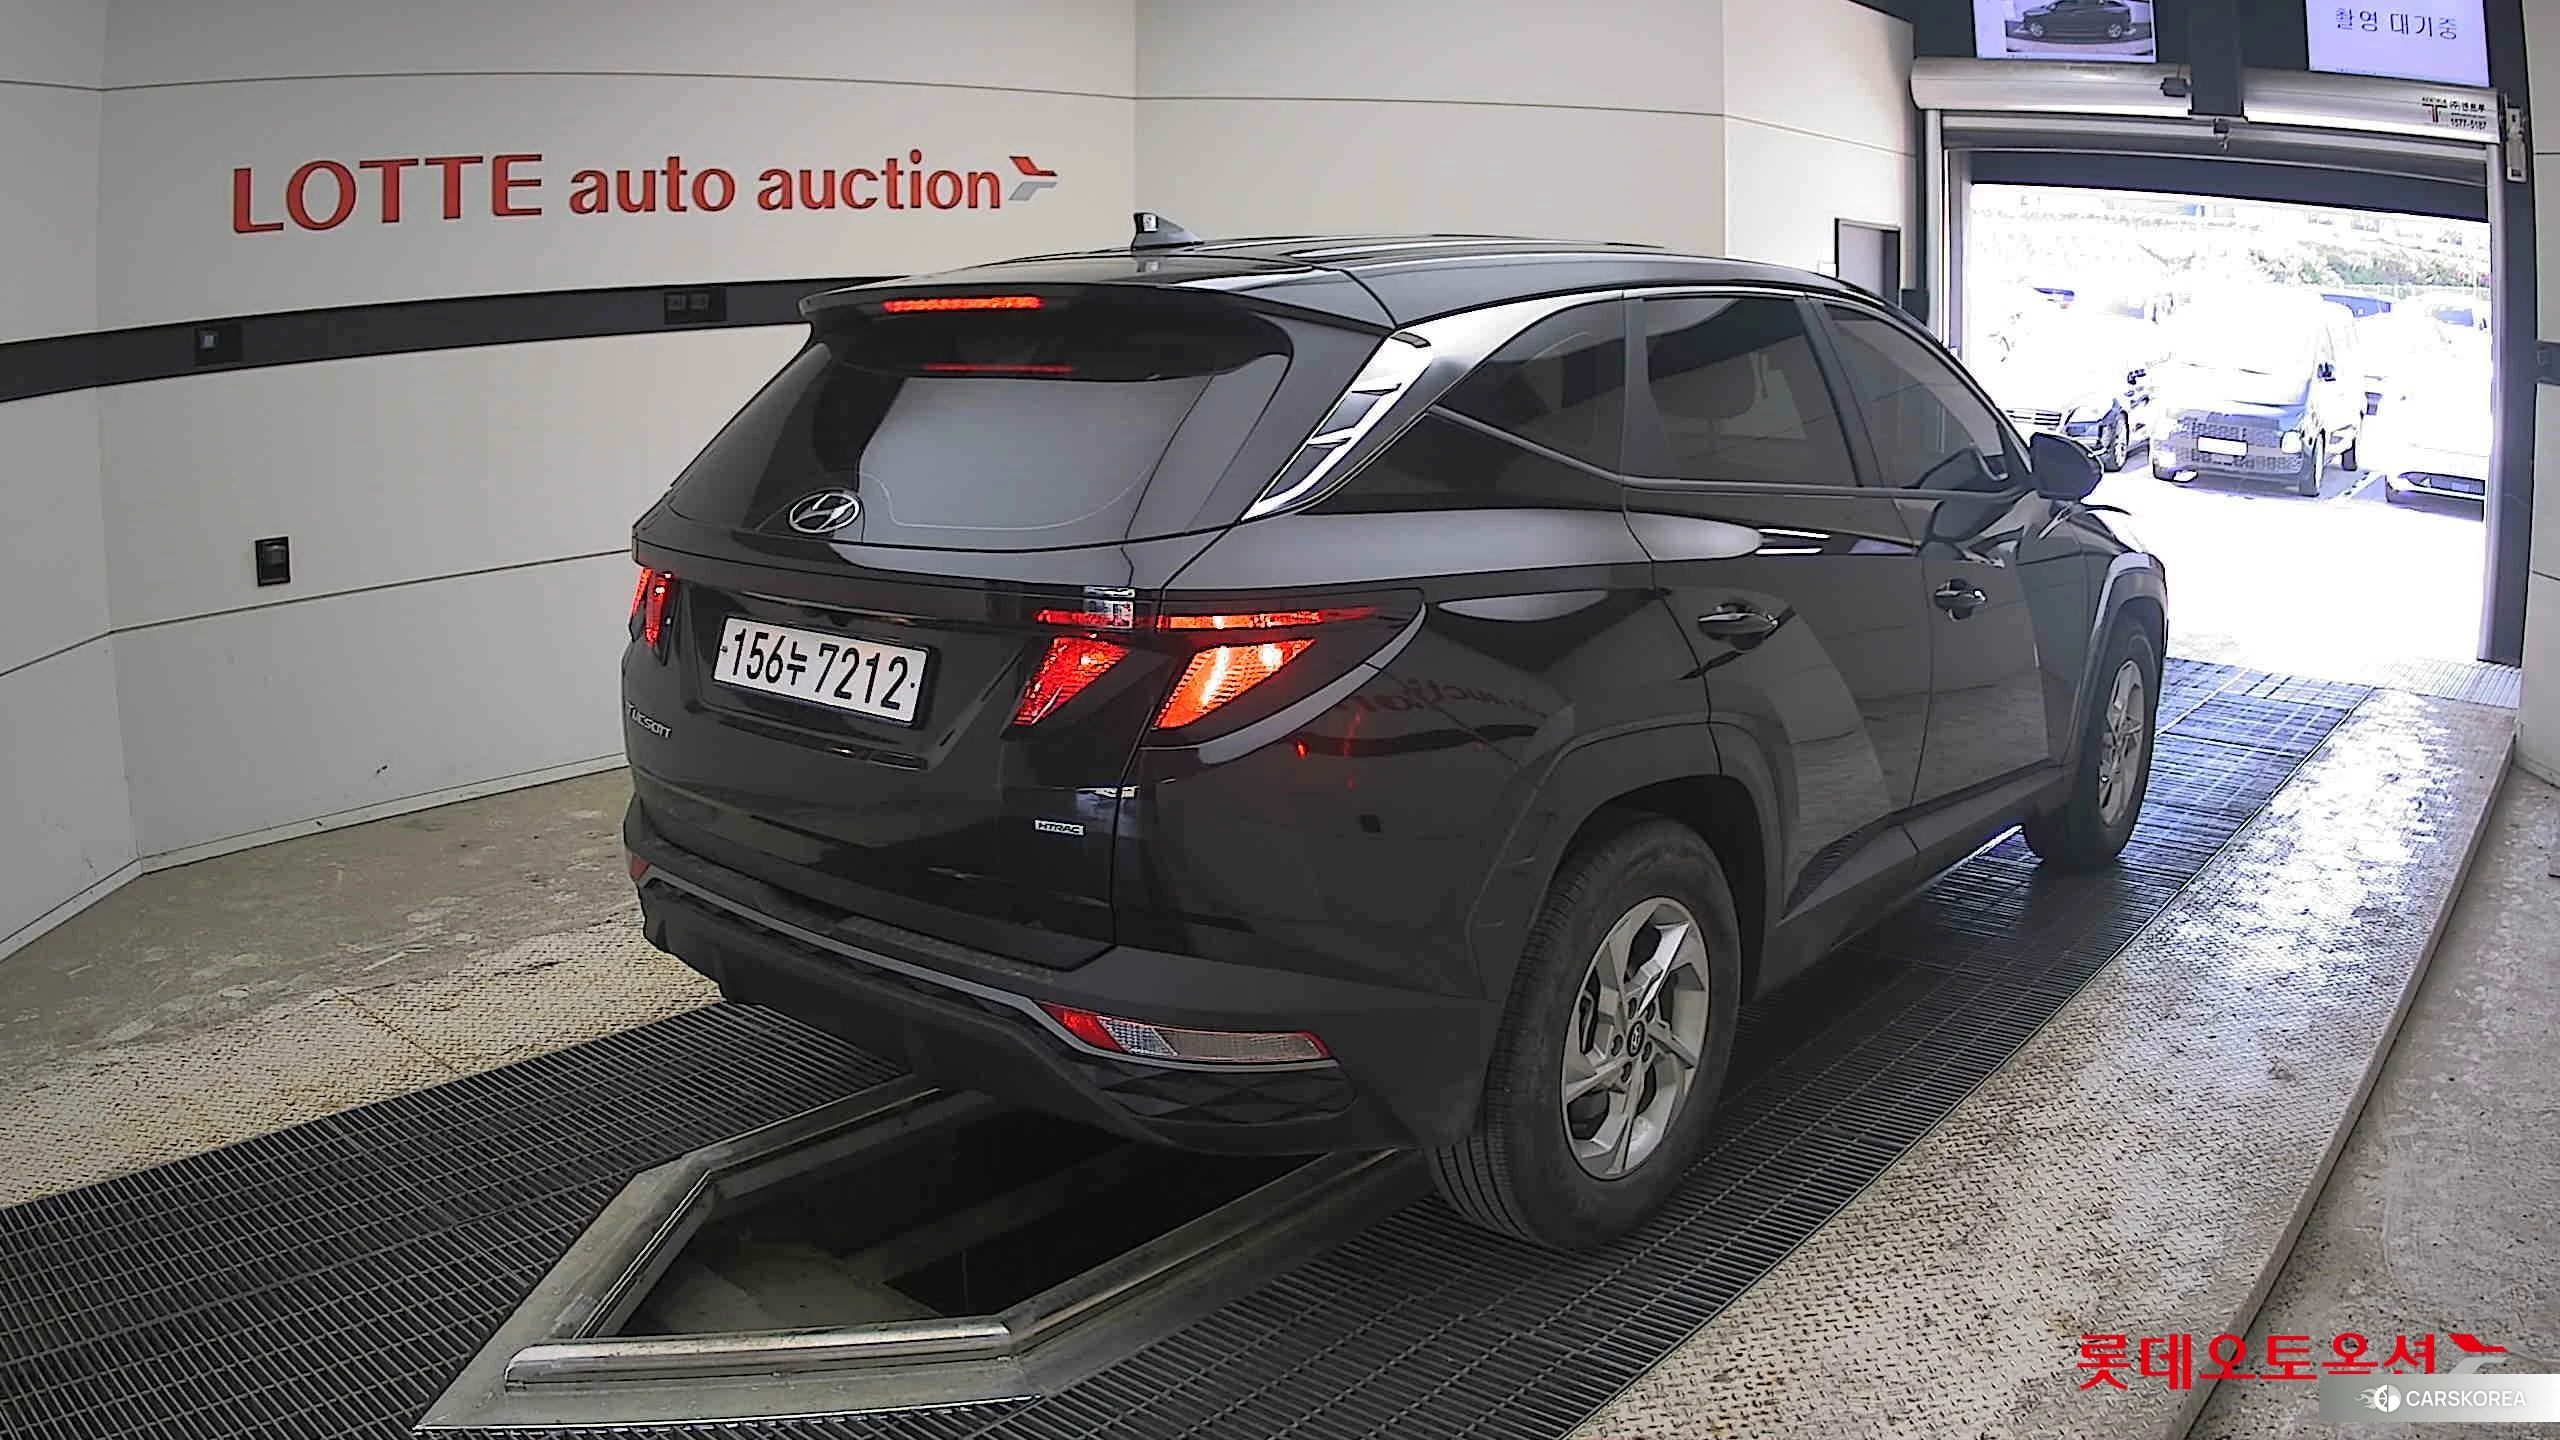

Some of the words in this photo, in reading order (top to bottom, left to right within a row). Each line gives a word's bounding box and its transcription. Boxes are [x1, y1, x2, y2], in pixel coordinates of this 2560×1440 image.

[2389, 13, 2457, 40] 대기중
[233, 154, 543, 233] LOTTE
[569, 156, 736, 214] auto
[757, 149, 1002, 212] auction
[1037, 821, 1082, 834] HTRAC
